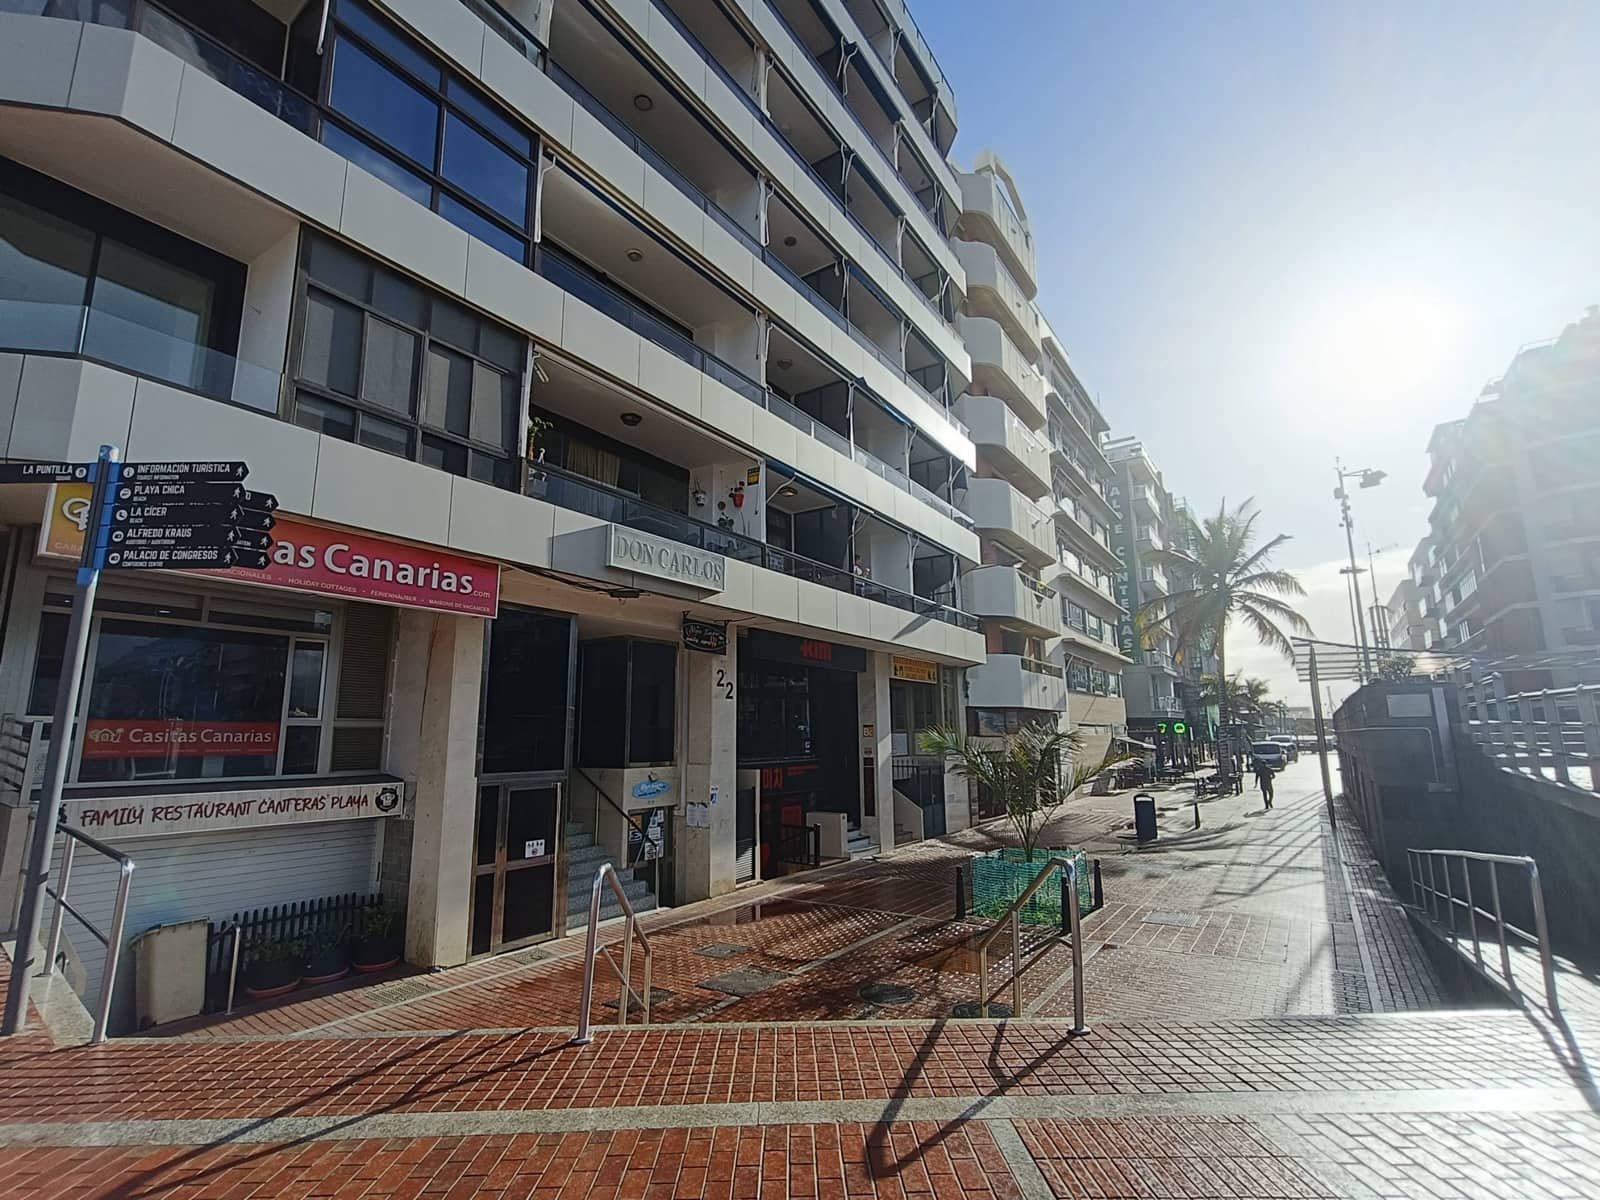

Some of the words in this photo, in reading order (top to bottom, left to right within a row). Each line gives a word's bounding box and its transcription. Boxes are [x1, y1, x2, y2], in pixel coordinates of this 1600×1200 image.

[23, 465, 34, 474] LA
[35, 465, 73, 474] PUNTILLA
[134, 485, 160, 495] PLAYA
[162, 484, 185, 494] CHICA
[130, 507, 142, 516] LA
[126, 528, 164, 538] ALFREDO
[164, 528, 192, 538] KRAUS
[123, 550, 158, 560] PALACIO
[159, 550, 171, 560] DE
[172, 550, 219, 560] CONGRESOS
[616, 536, 655, 567] DON
[658, 548, 722, 582] CARLOS
[128, 728, 198, 745] Casitas
[200, 728, 273, 744] Canarias
[80, 806, 144, 828] FAMILY
[151, 800, 257, 823] RESTAURANT
[258, 795, 327, 815] CANTERAS
[330, 794, 369, 810] PLAYA
